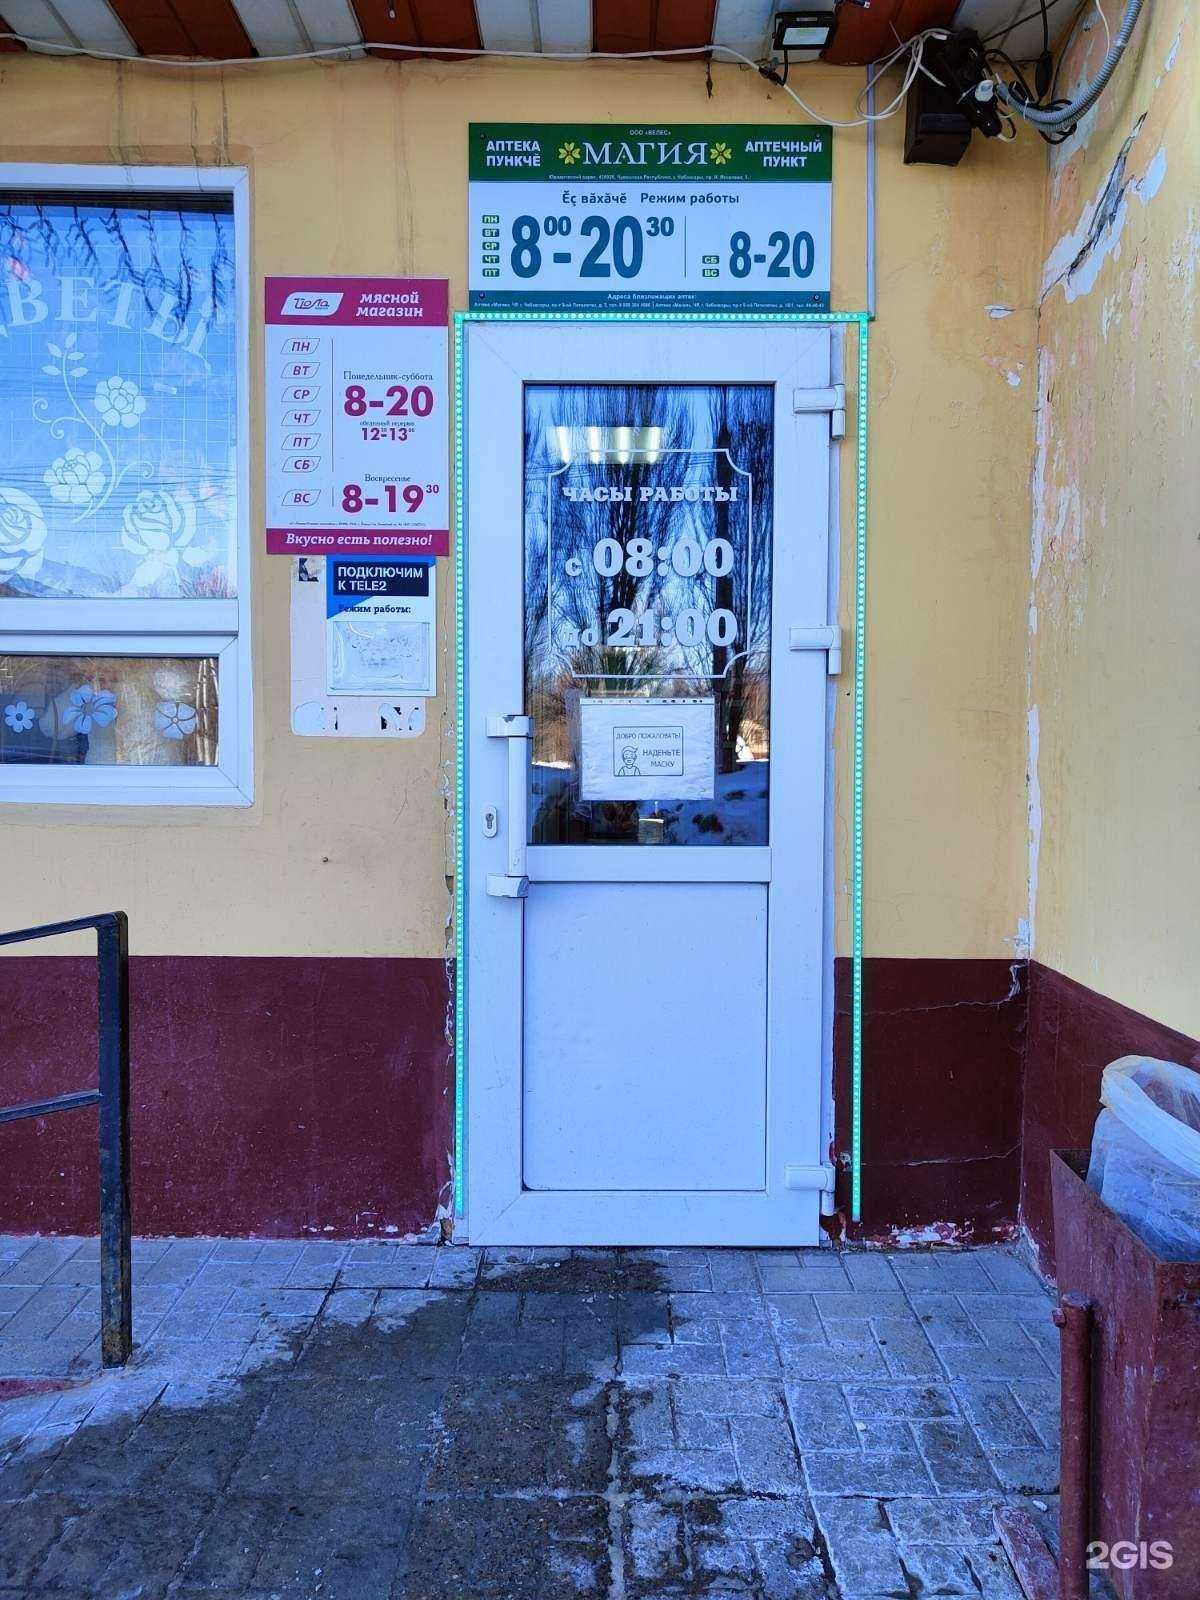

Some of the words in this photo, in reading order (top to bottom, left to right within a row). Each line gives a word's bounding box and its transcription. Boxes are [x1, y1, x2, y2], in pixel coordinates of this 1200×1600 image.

[486, 140, 541, 152] АПТЕКА
[745, 138, 822, 153] АПТЕЧНЫЙ
[582, 142, 709, 165] МАГИЯ
[763, 156, 807, 167] ПУНКТ
[641, 192, 686, 203] Режим
[690, 192, 739, 206] работы
[484, 229, 498, 237] ВТ
[704, 256, 718, 264] СБ
[729, 231, 815, 278] 8-20
[484, 269, 498, 277] ПТ
[704, 269, 718, 277] ВС
[360, 291, 419, 304] мясной
[0, 275, 213, 352] ВЕТЫ
[355, 306, 423, 317] магазин
[292, 341, 310, 352] ПН
[293, 365, 311, 376] ВТ
[293, 389, 310, 399] СР
[344, 385, 434, 417] 8-20
[294, 413, 311, 423] ЧТ
[293, 437, 311, 447] ПТ
[294, 459, 310, 470] СБ
[294, 493, 311, 503] ВС
[562, 487, 632, 502] ЧАСЫ
[640, 486, 738, 502] РАБОТЫ
[286, 533, 335, 547] Вкусно
[337, 537, 370, 545] есть
[373, 535, 432, 546] полезно!
[565, 558, 582, 577] с
[593, 538, 734, 577] 08:00
[338, 566, 423, 578] ПОДКЛЮЧИМ
[338, 580, 346, 591] К
[349, 580, 387, 591] TELE2
[373, 604, 411, 614] работы:
[607, 608, 738, 647] 21:00
[642, 749, 680, 757] НАДЕНЬТЕ
